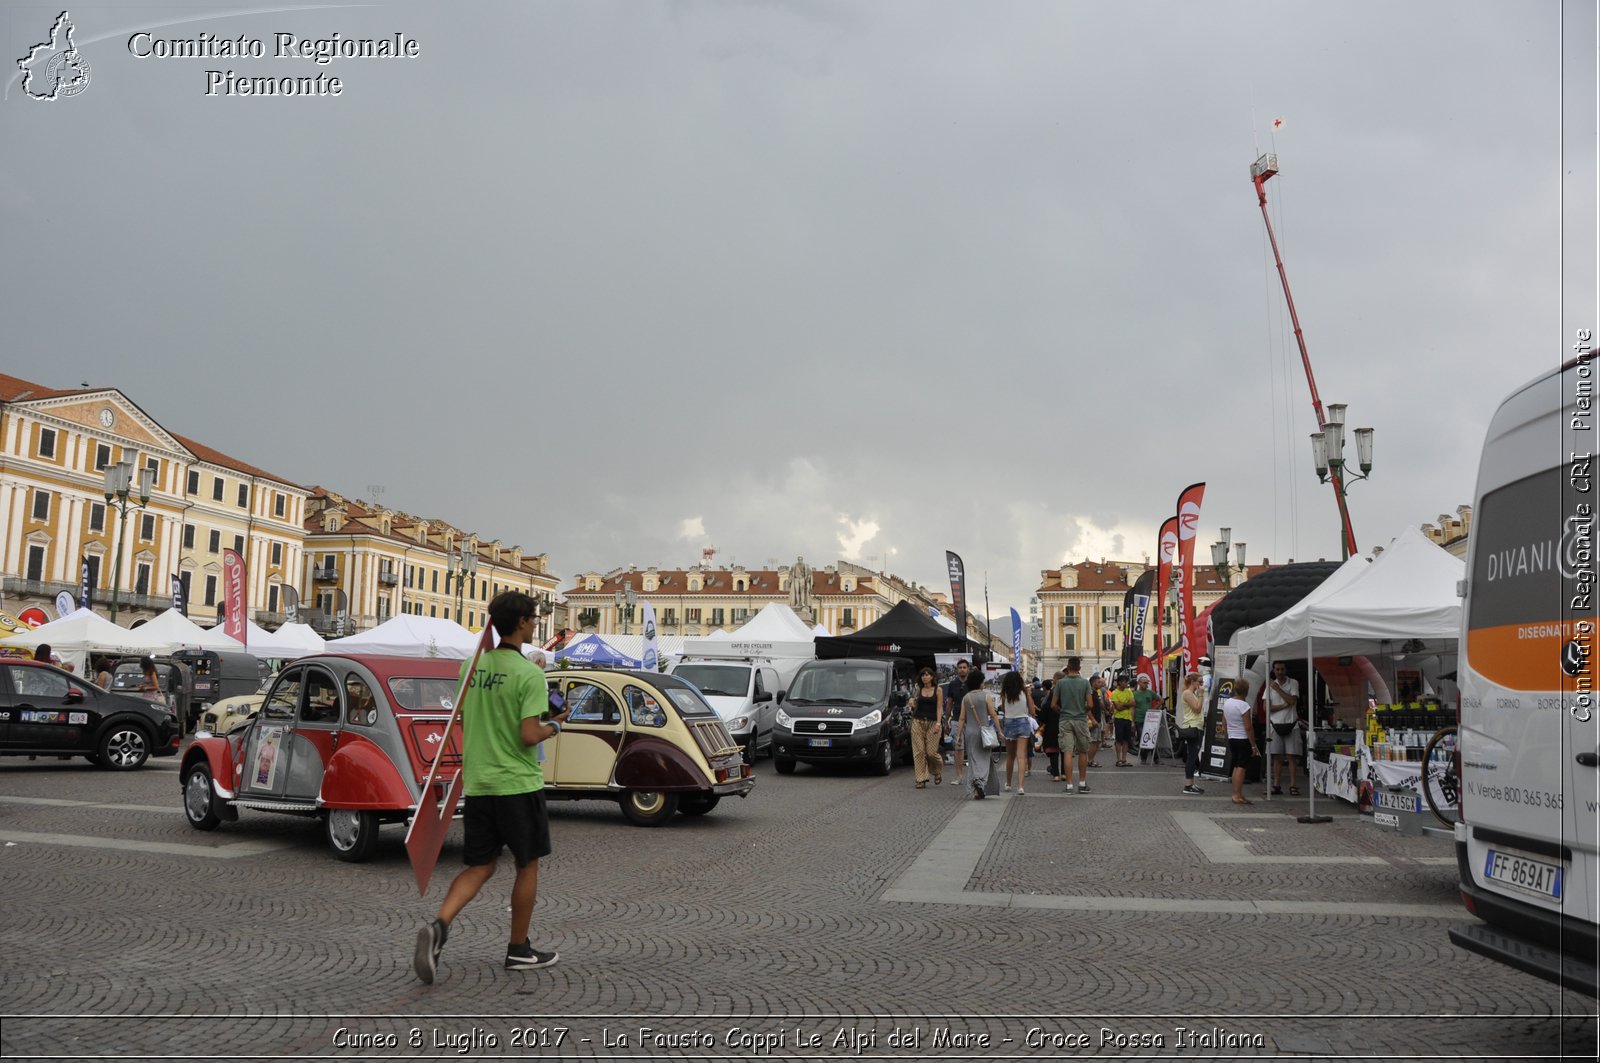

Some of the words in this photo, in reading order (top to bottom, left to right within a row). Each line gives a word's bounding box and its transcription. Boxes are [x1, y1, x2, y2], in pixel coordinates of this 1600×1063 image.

[1488, 540, 1552, 581] DIVANI
[1133, 608, 1145, 639] LOOK
[1518, 622, 1571, 639] DISEGNATI
[469, 669, 508, 691] STAFF
[1496, 698, 1520, 710] TORINO
[1537, 698, 1568, 710] BORGO
[1390, 795, 1416, 811] 215GX
[1467, 782, 1476, 796] N.
[1477, 783, 1503, 801] Verde
[1504, 786, 1521, 804] 800
[1523, 789, 1542, 807] 365
[1544, 792, 1563, 810] 365
[1492, 853, 1510, 878] FF
[1511, 859, 1555, 892] 869AT
